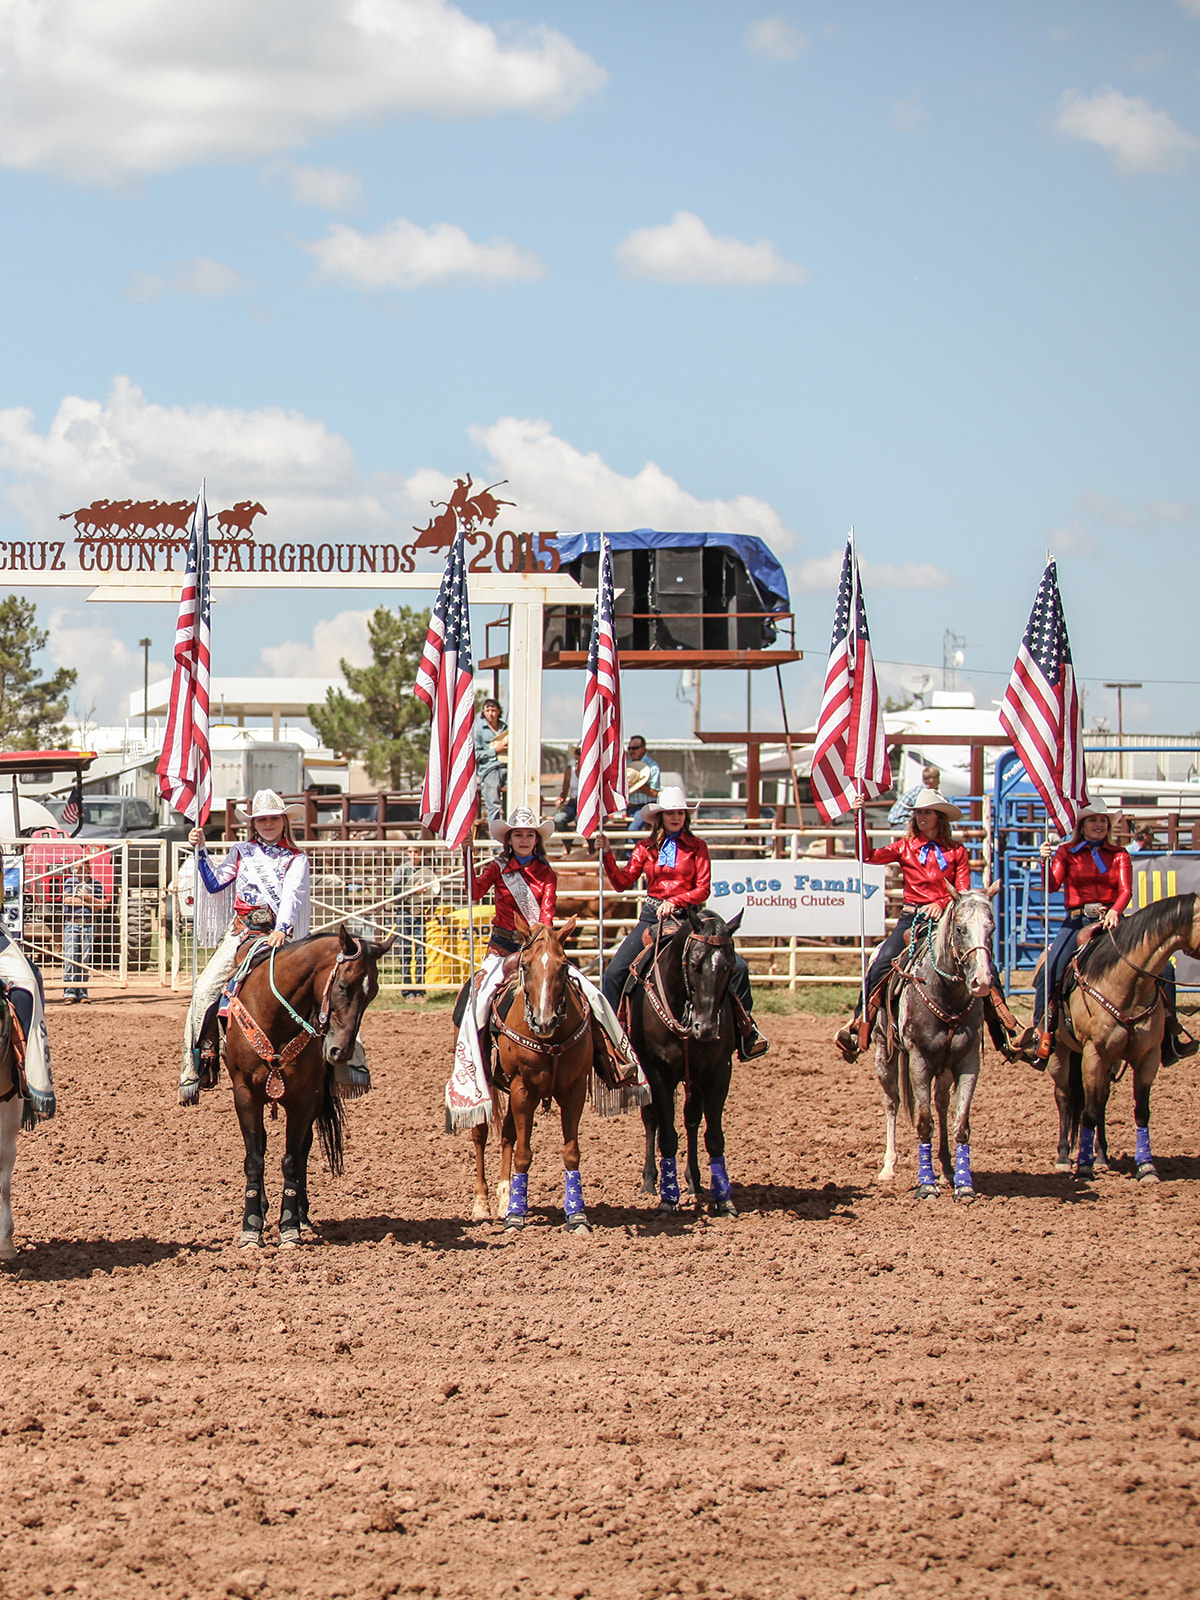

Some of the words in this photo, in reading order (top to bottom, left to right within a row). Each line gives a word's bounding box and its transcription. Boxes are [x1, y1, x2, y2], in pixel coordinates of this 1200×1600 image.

[211, 543, 416, 573] FAIRGROUNDS
[467, 530, 561, 573] 2015
[712, 877, 782, 897] Boice
[794, 875, 880, 899] Family
[746, 895, 797, 909] Bucking
[801, 895, 845, 907] Chutes
